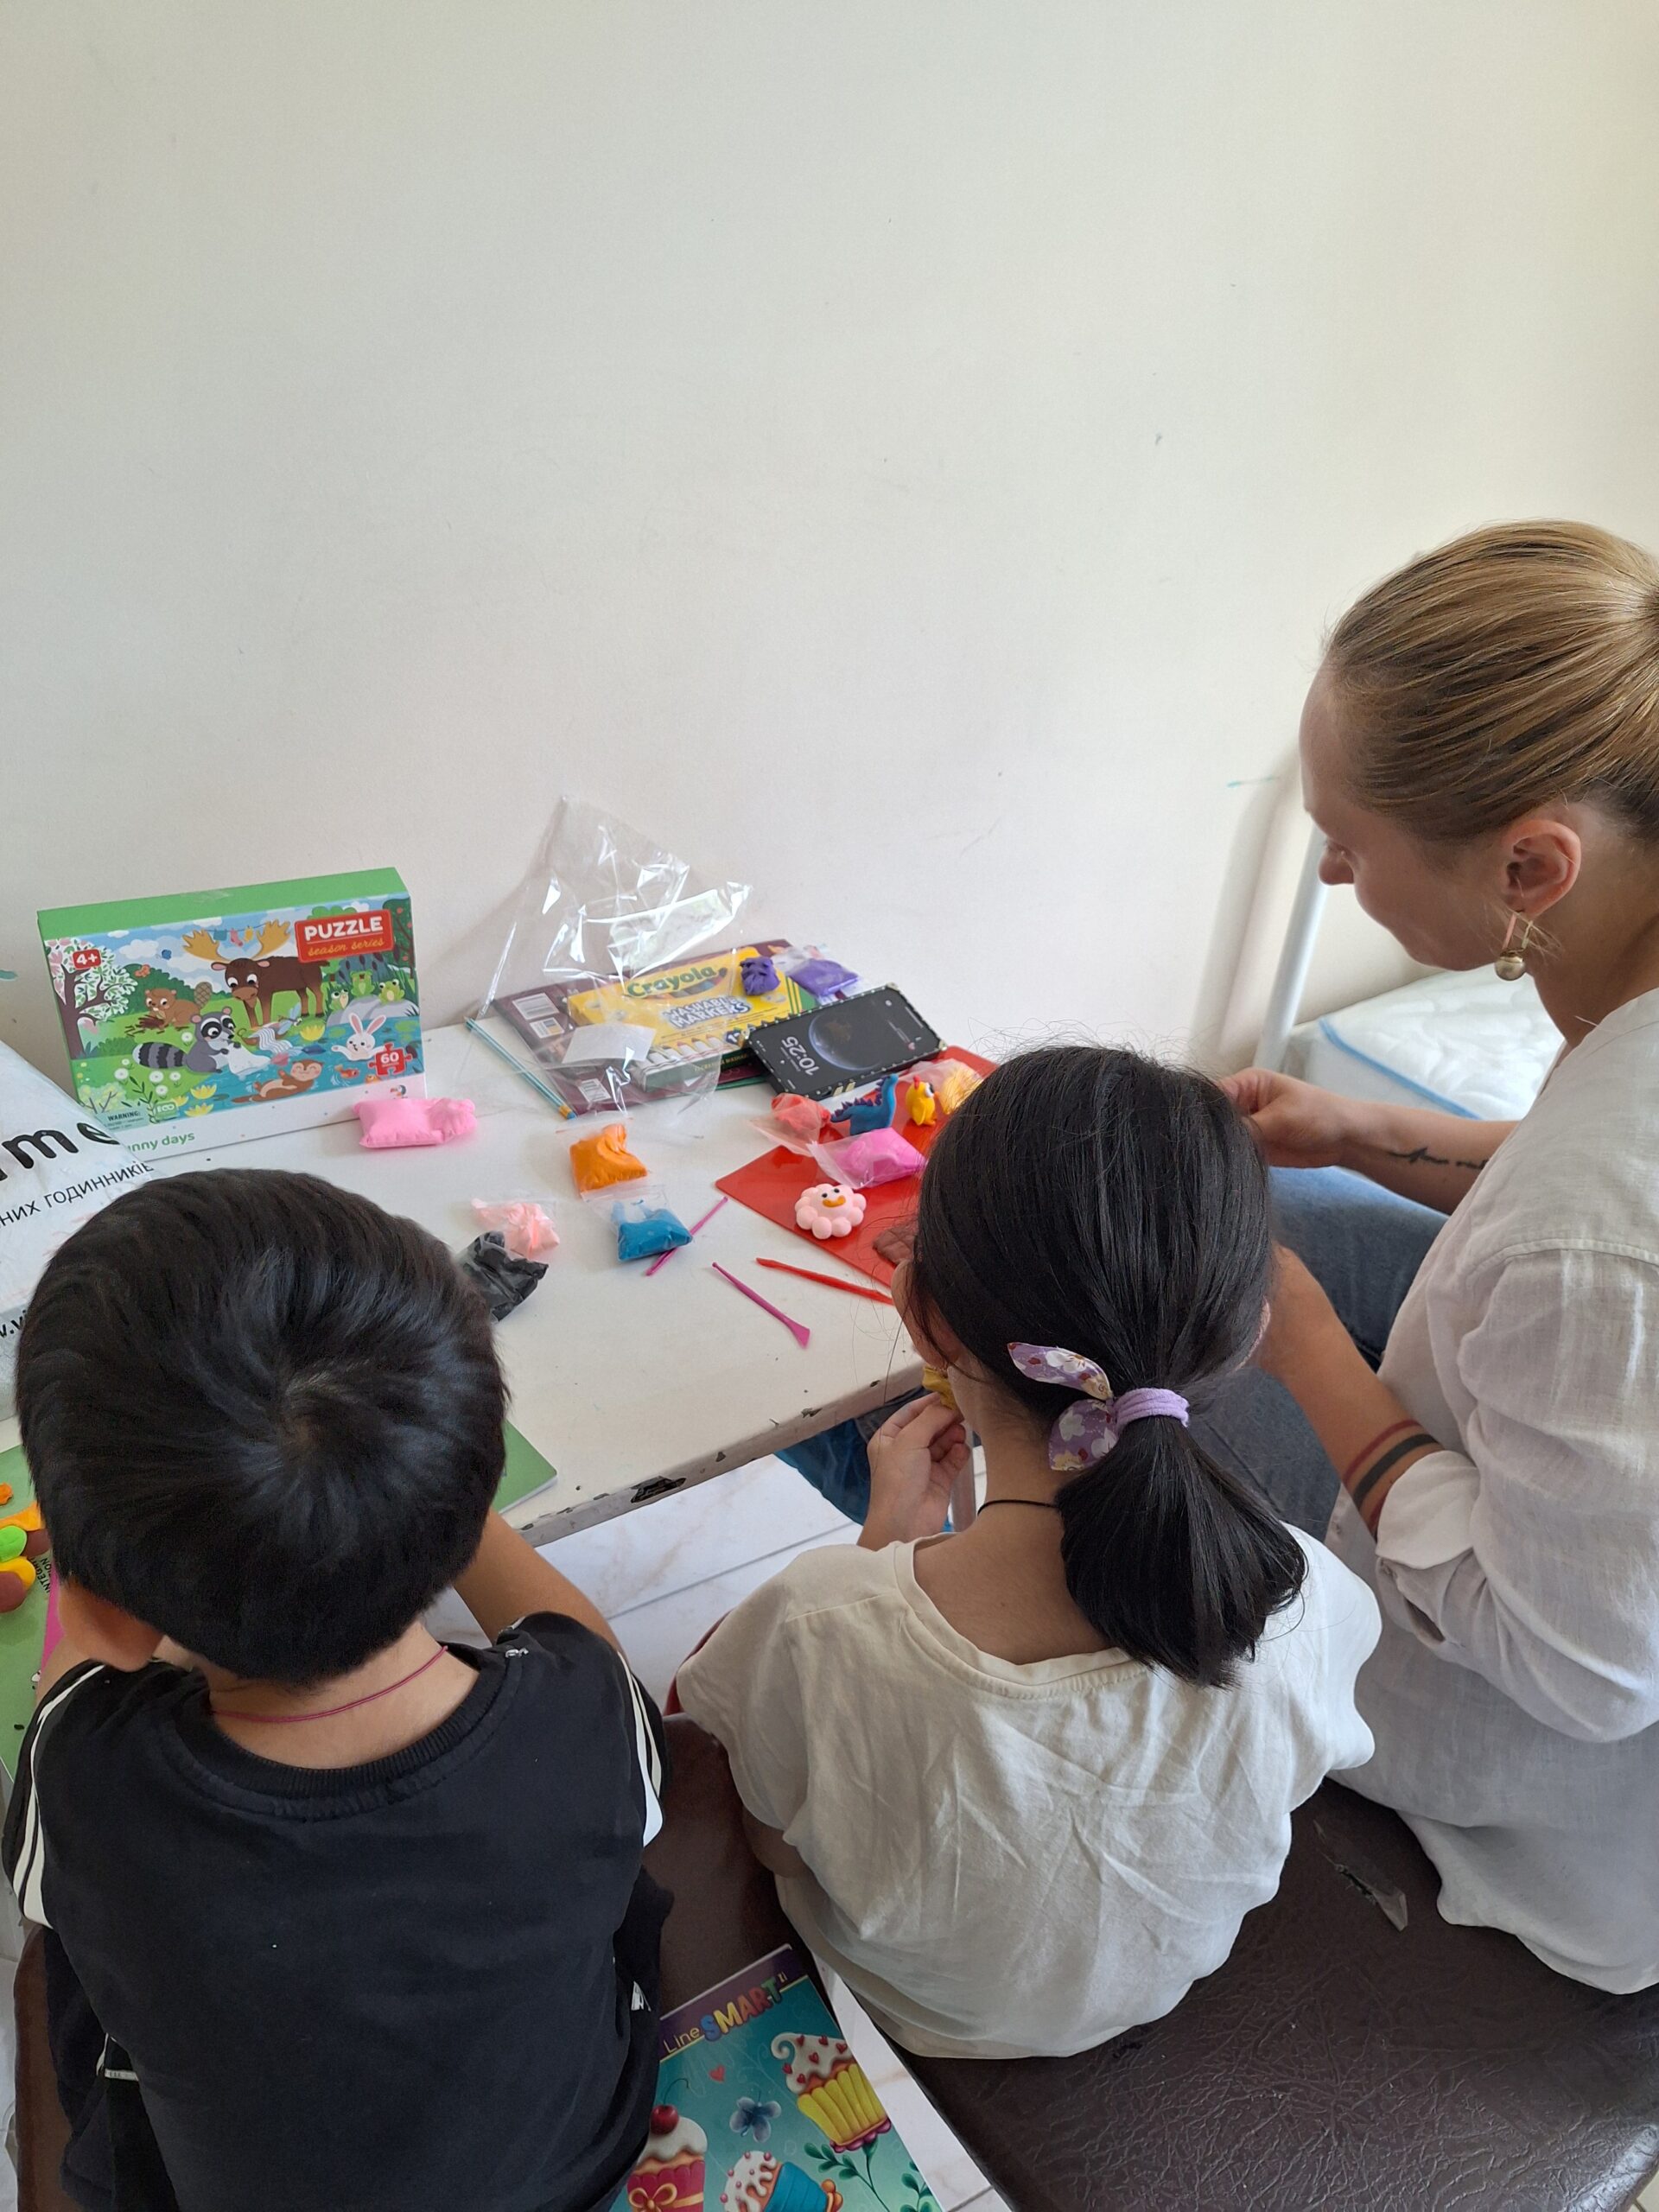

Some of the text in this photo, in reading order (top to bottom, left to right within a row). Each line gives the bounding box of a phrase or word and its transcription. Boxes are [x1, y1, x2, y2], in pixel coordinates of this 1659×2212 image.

[304, 916, 384, 941] PUZZLE
[308, 938, 385, 957] season series
[76, 953, 99, 965] 4+
[626, 966, 717, 997] Crayola
[671, 1000, 751, 1029] MARKERS
[380, 1052, 399, 1064] 60
[781, 1036, 820, 1076] 10:25
[107, 1111, 141, 1122] WARNING:
[156, 1104, 175, 1114] ECO
[162, 1132, 195, 1147] days
[0, 1122, 121, 1181] me
